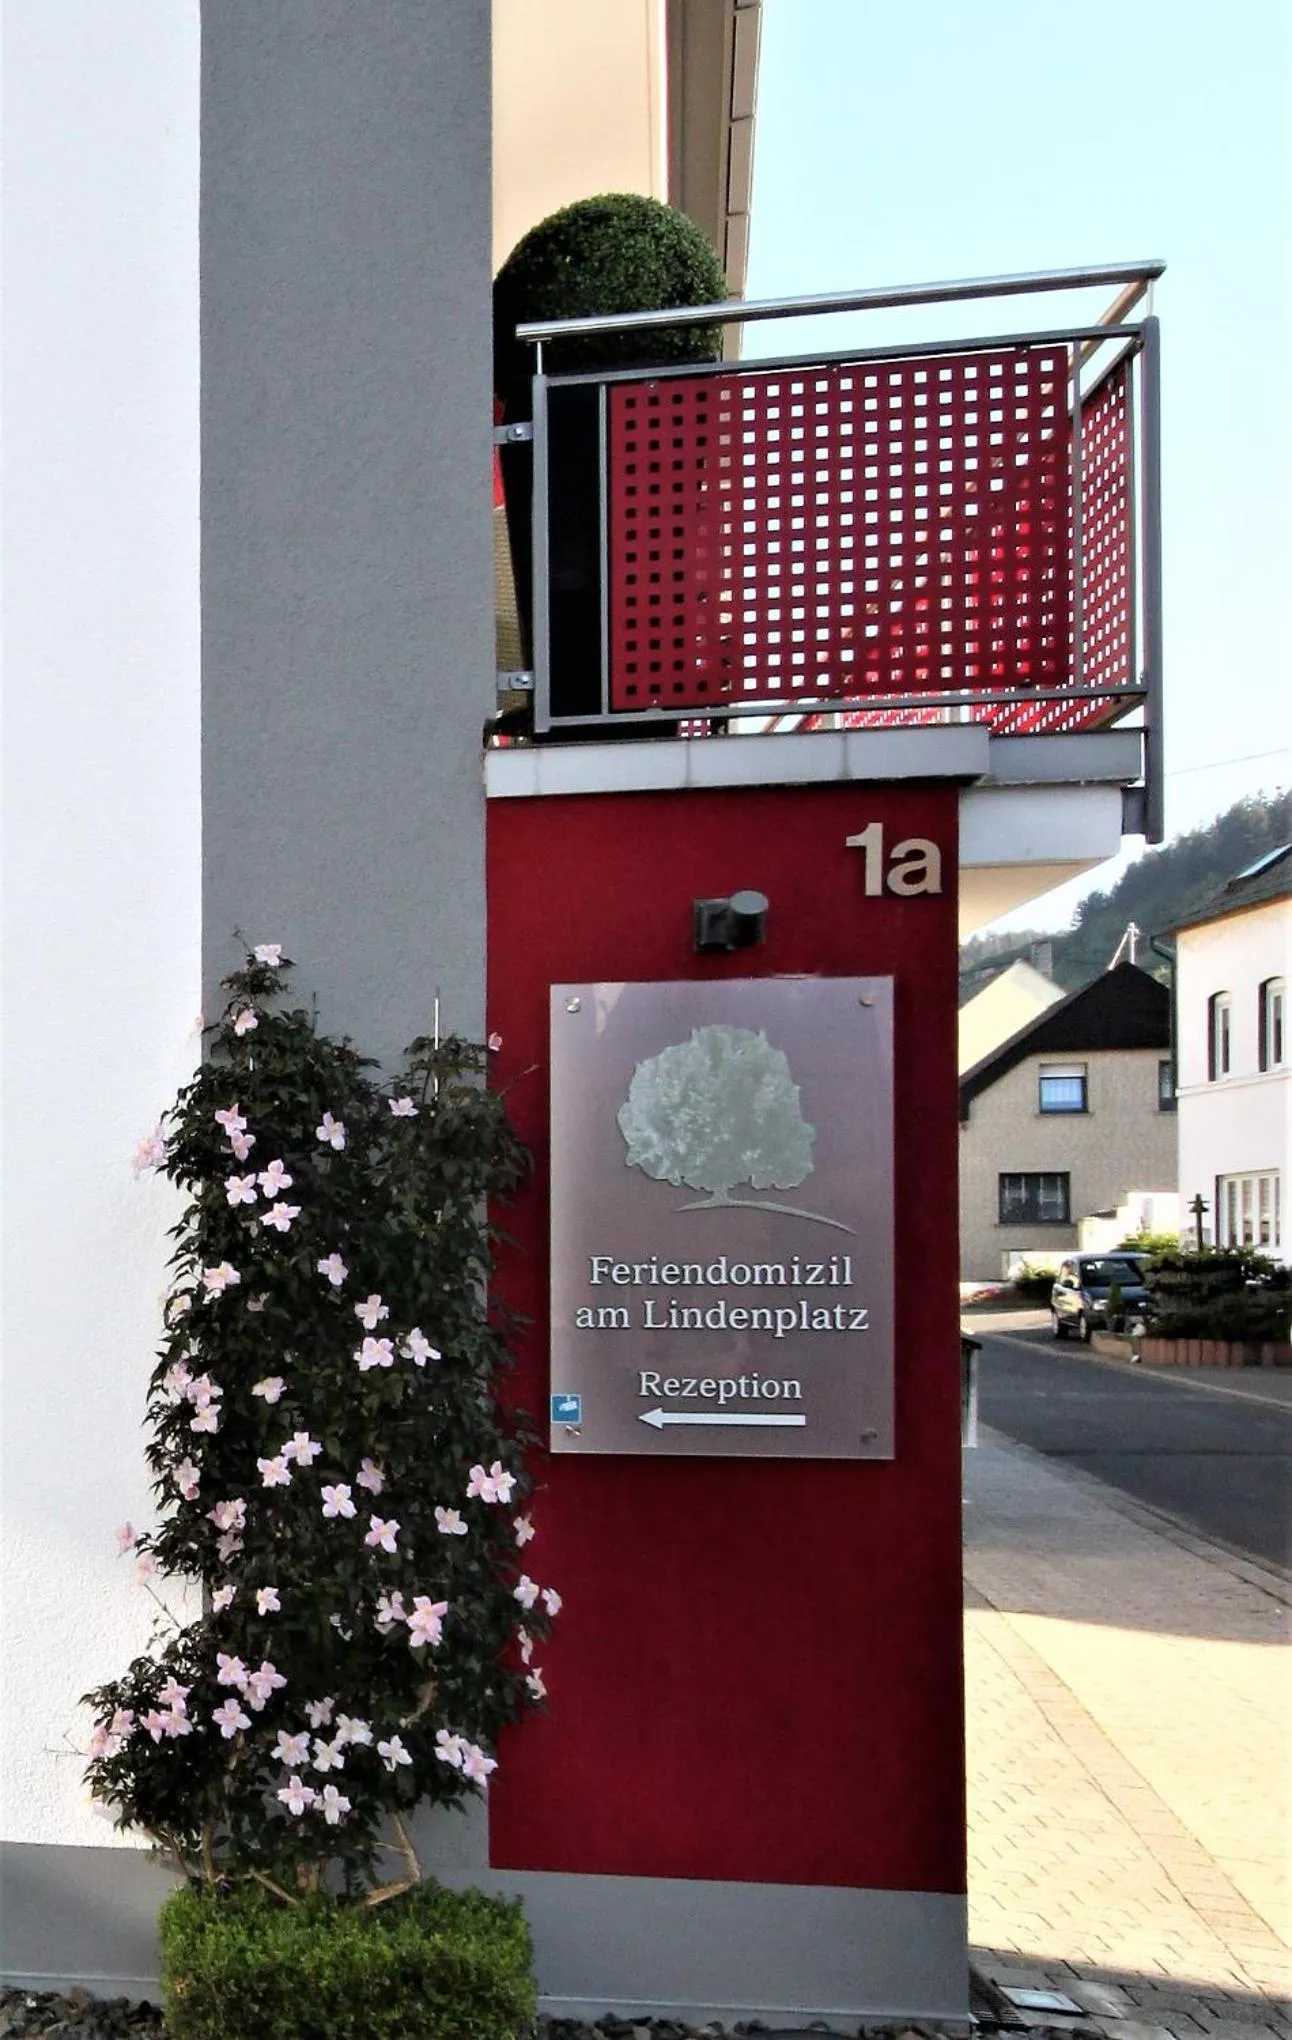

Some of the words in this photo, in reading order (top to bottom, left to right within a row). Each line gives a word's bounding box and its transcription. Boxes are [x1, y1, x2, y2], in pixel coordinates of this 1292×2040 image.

[846, 821, 943, 897] 1a
[588, 1255, 854, 1286] Feriendomizil
[575, 1305, 631, 1330] am
[643, 1300, 869, 1338] Lindenplatz
[638, 1371, 802, 1404] Rezeption
